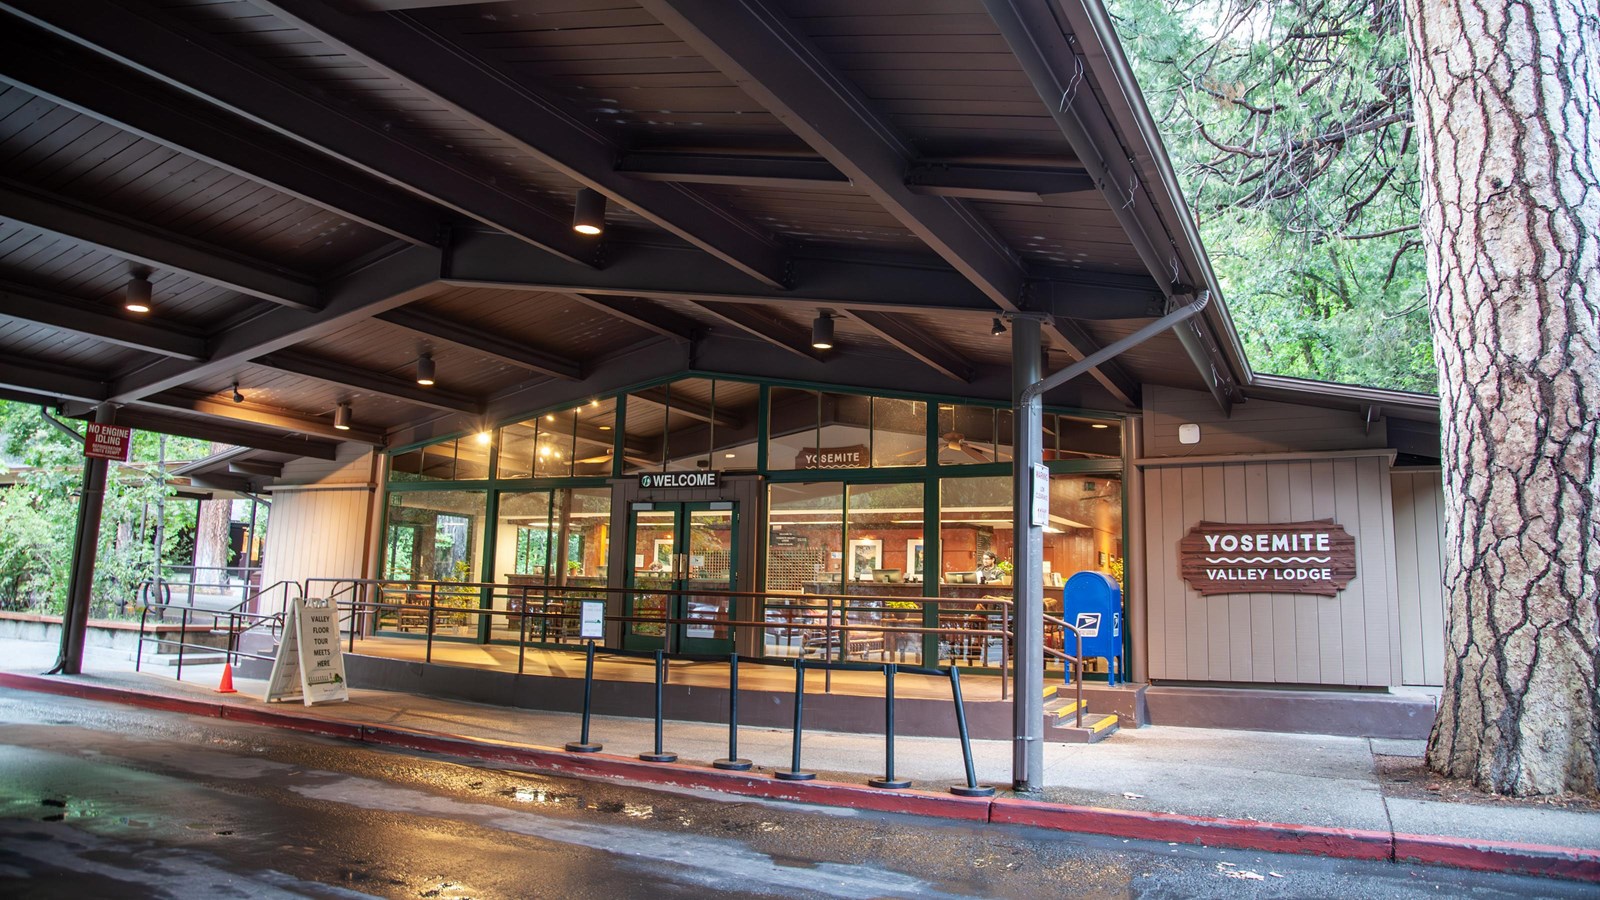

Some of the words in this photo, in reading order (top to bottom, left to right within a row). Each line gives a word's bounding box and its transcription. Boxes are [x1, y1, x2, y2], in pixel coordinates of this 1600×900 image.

[88, 424, 100, 434] NO
[101, 426, 129, 439] ENGINE
[95, 434, 121, 446] IDLING
[805, 452, 860, 464] YOSEMITE
[653, 473, 716, 487] WELCOME
[1204, 533, 1330, 552] YOSEMITE
[1206, 568, 1268, 580] VALLEY
[1274, 568, 1332, 580] LODGE
[310, 615, 330, 623] VALLEY
[312, 626, 329, 634] FLOOR
[313, 648, 331, 656] MEETS
